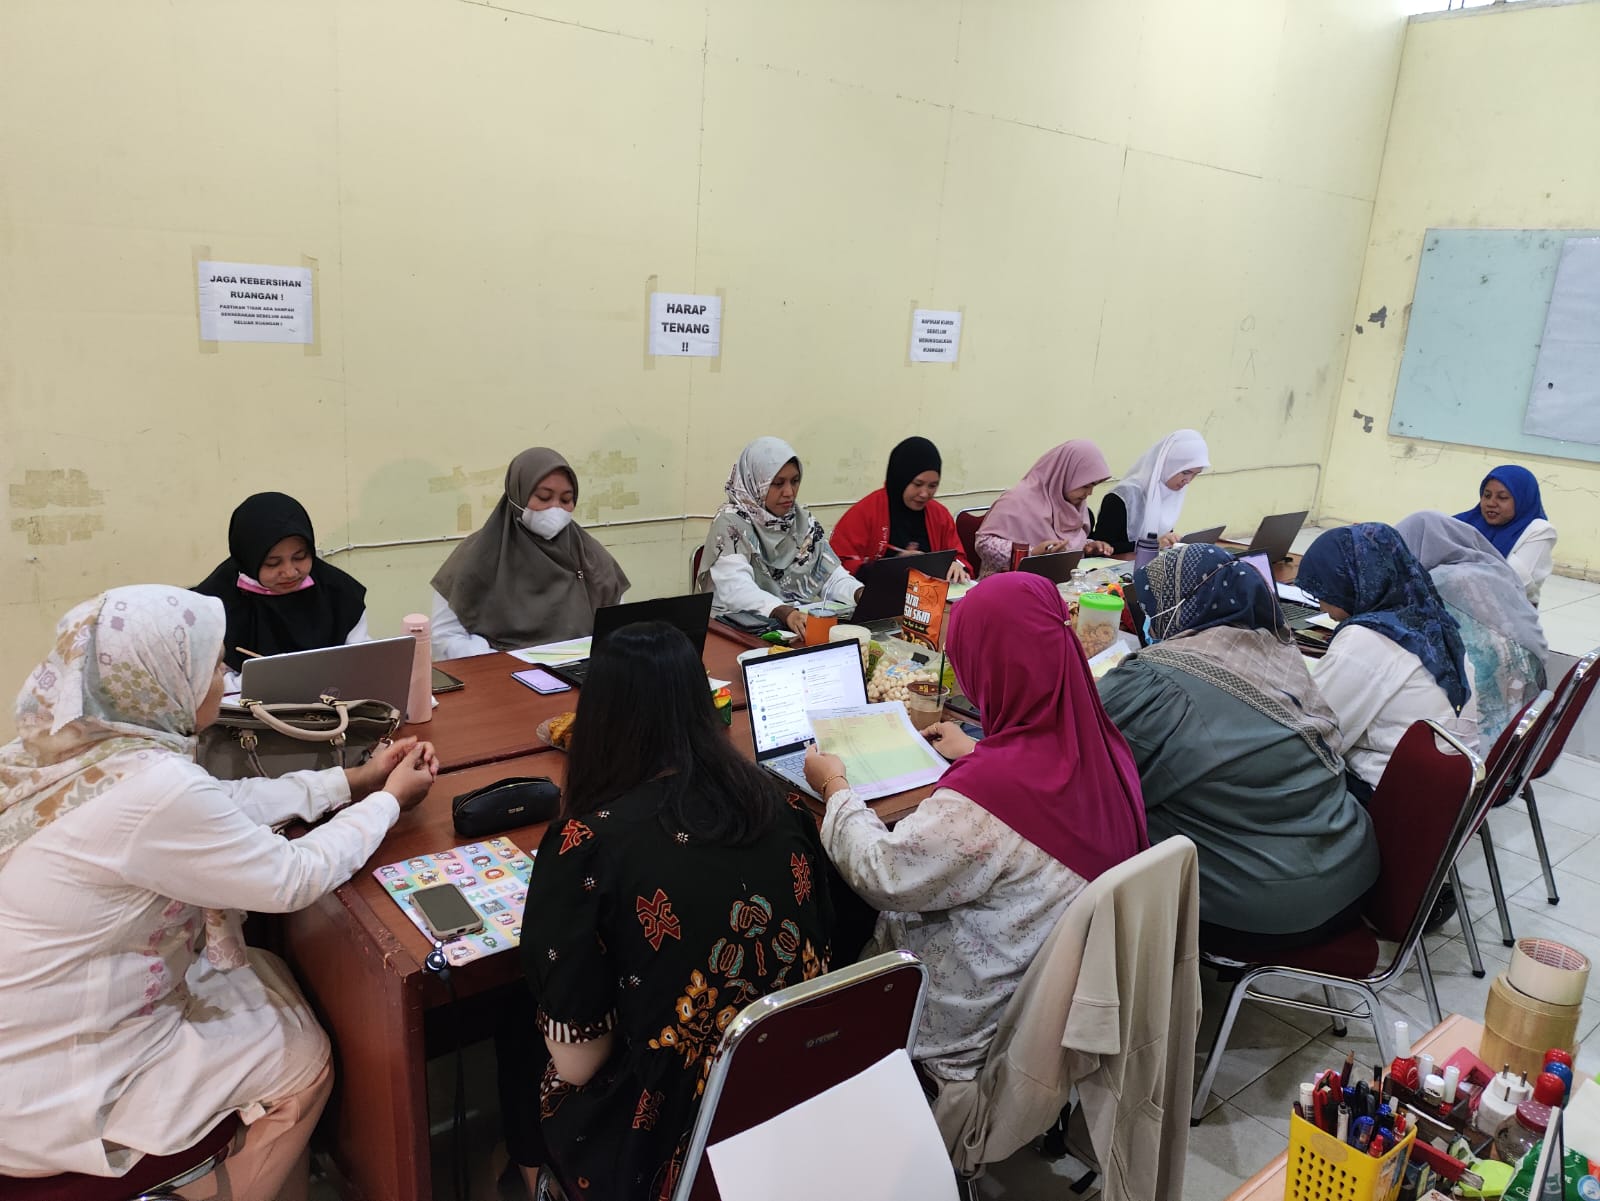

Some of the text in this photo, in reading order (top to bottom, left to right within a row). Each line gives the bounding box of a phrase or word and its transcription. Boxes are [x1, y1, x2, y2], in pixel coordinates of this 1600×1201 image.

[210, 275, 302, 288] JAGA KEBERSIHAN
[230, 291, 278, 301] RUANGAN
[666, 303, 707, 315] HARAP
[661, 322, 710, 334] TENANG
[681, 341, 689, 352] !!
